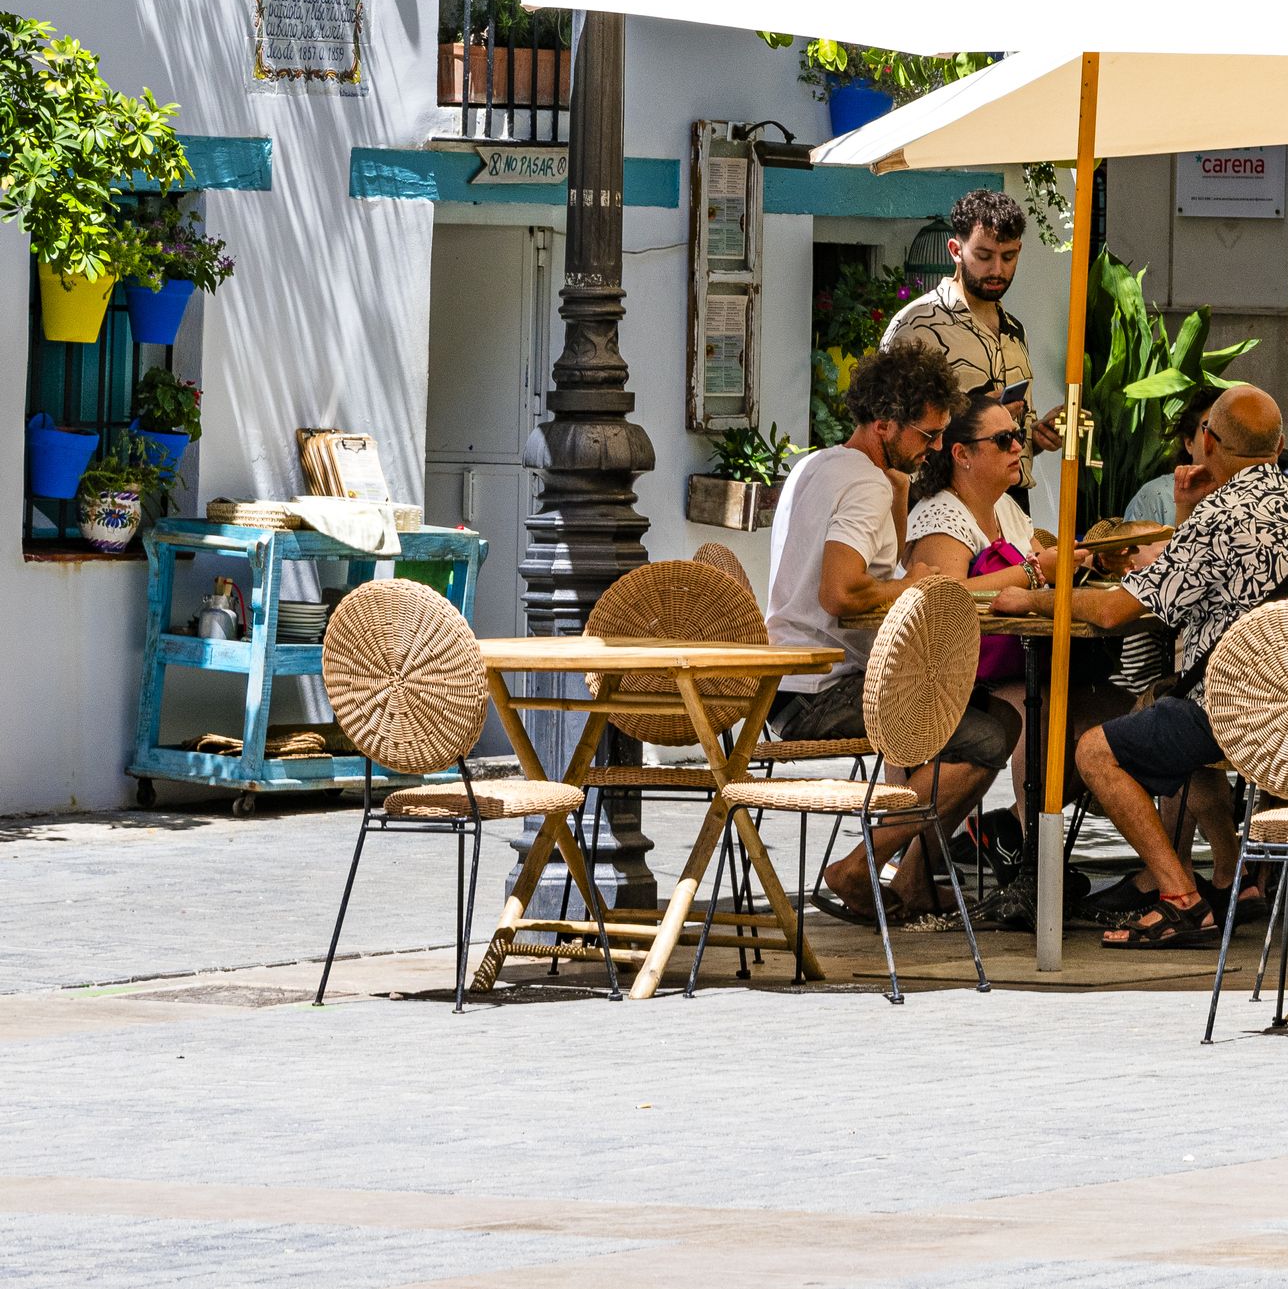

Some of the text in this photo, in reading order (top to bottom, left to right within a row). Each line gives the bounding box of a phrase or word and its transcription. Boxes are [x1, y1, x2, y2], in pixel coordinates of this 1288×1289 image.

[266, 40, 295, 59] desde
[299, 46, 317, 61] 1857
[327, 46, 345, 62] 1859
[503, 155, 556, 177] NO PASAR
[1202, 158, 1265, 174] carena
